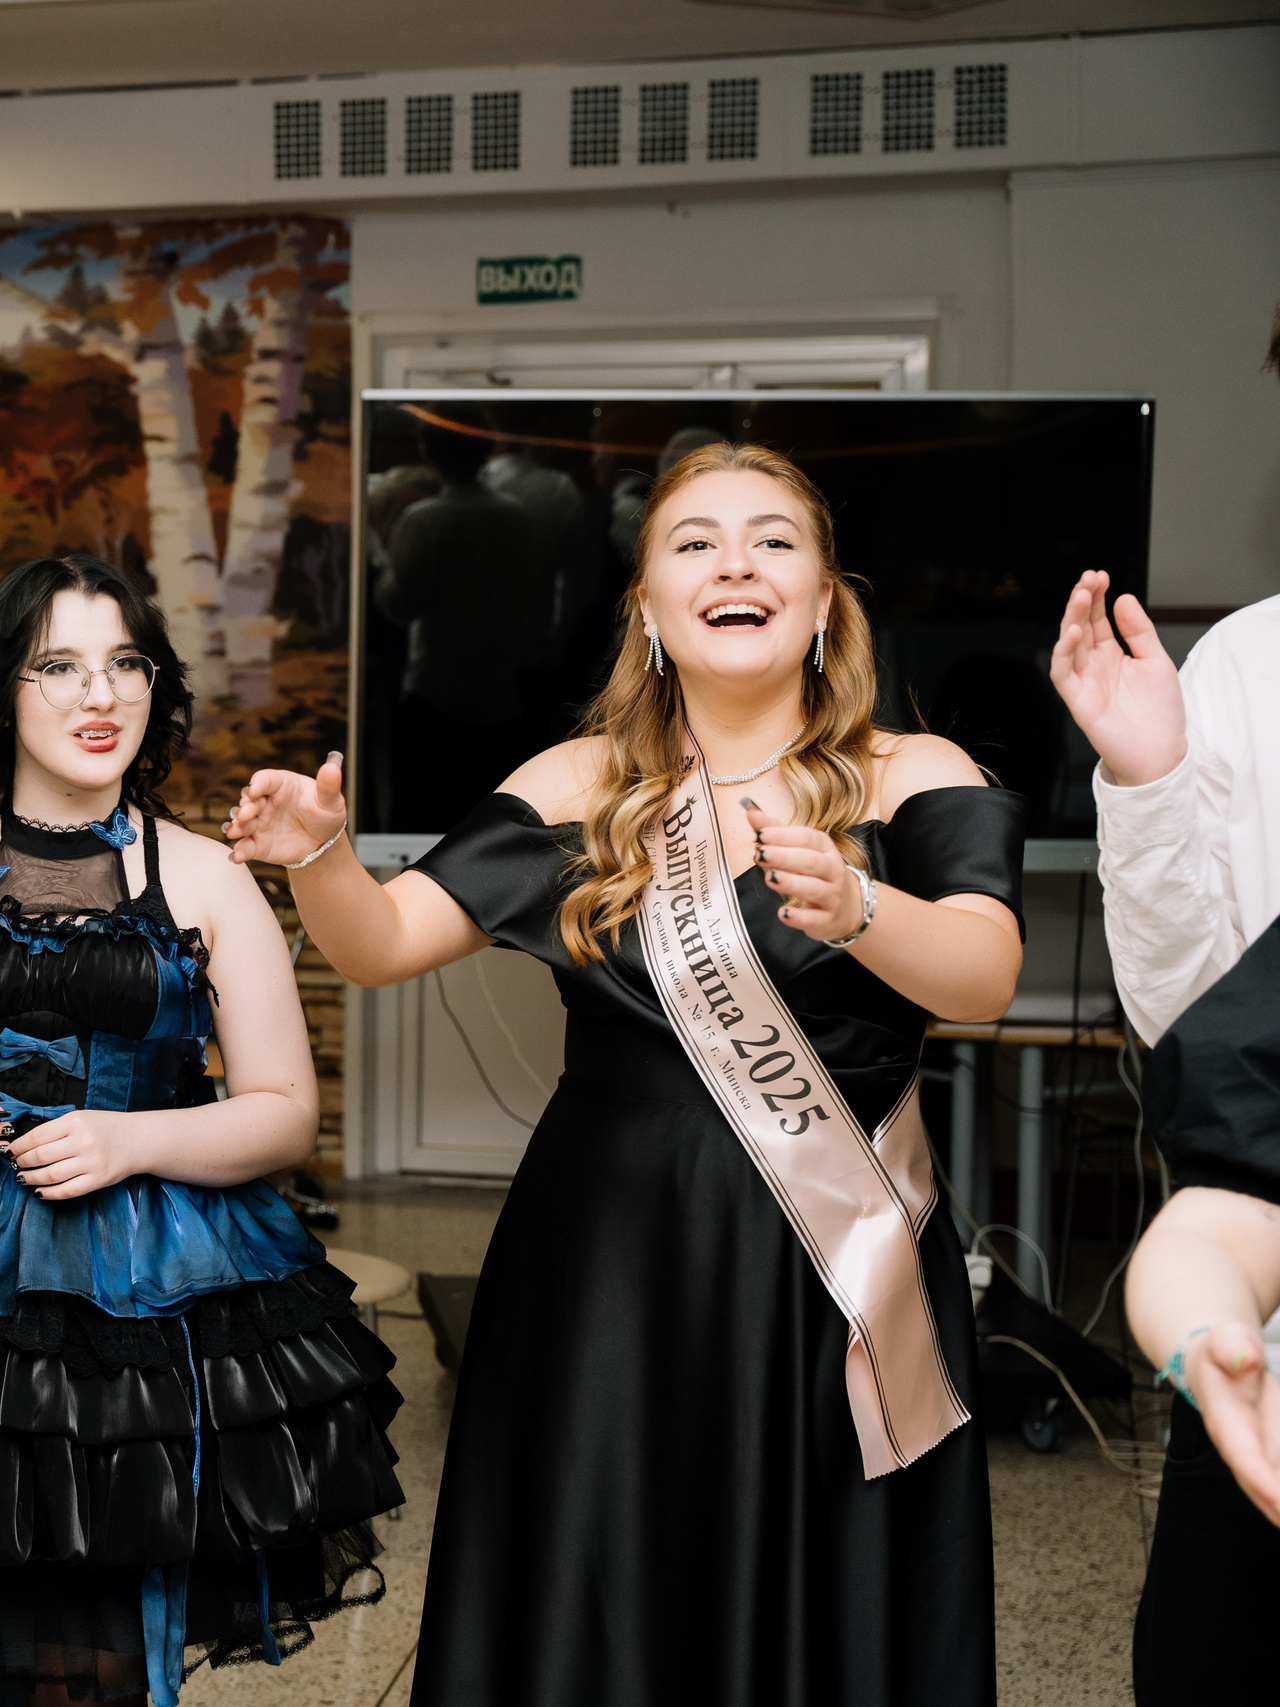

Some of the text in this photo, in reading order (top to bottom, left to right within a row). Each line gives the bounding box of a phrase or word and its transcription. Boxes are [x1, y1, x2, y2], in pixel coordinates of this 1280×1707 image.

[480, 264, 579, 296] ВЫХОД
[656, 803, 831, 1136] Выпускница 2025
[693, 839, 739, 979] Пригодская Альбина
[652, 901, 752, 1111] Средняя школа № 15 г. Минска
